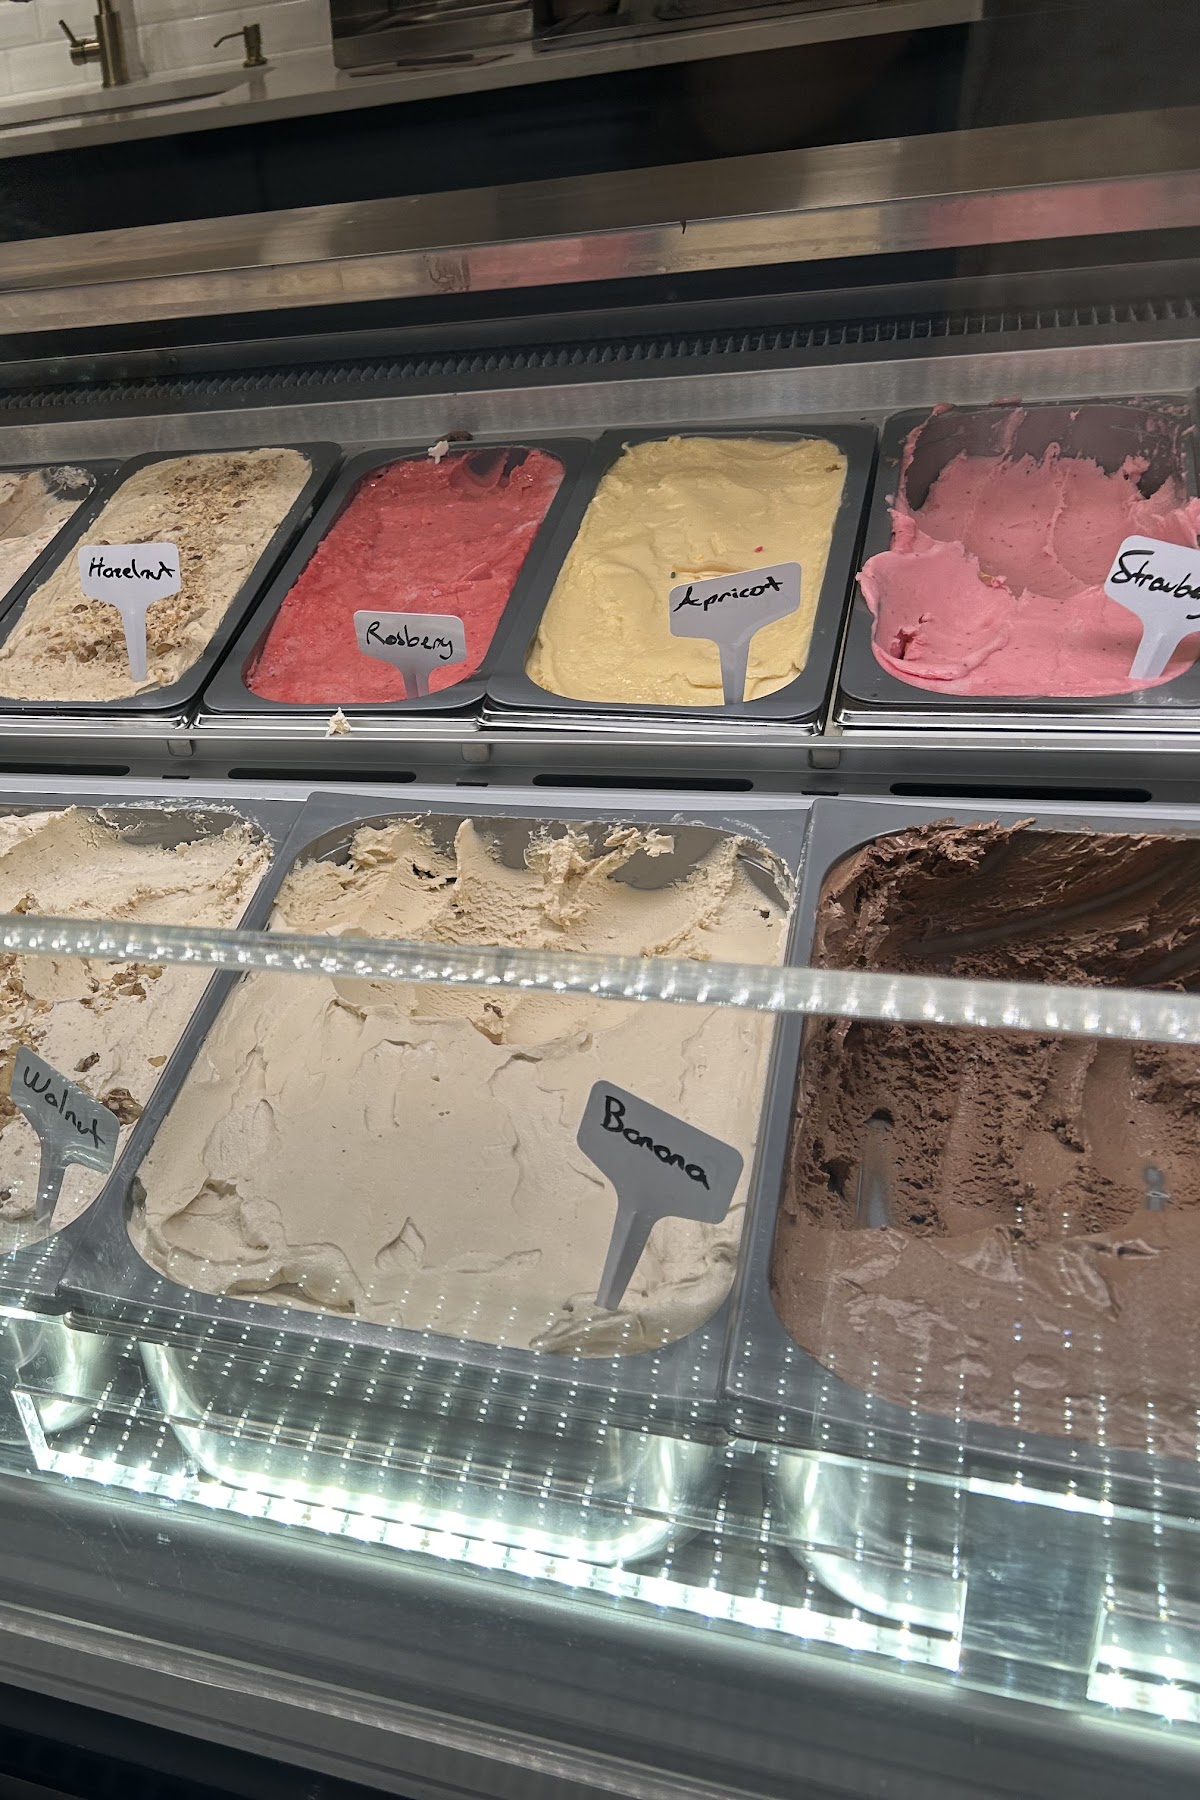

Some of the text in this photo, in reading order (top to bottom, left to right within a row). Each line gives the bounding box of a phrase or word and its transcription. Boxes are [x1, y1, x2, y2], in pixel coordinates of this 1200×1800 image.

[88, 556, 175, 580] Hazelnut
[672, 576, 783, 612] Apricot
[1110, 549, 1200, 619] Strawbe
[23, 1066, 105, 1149] Walnut
[600, 1095, 710, 1190] Banana
